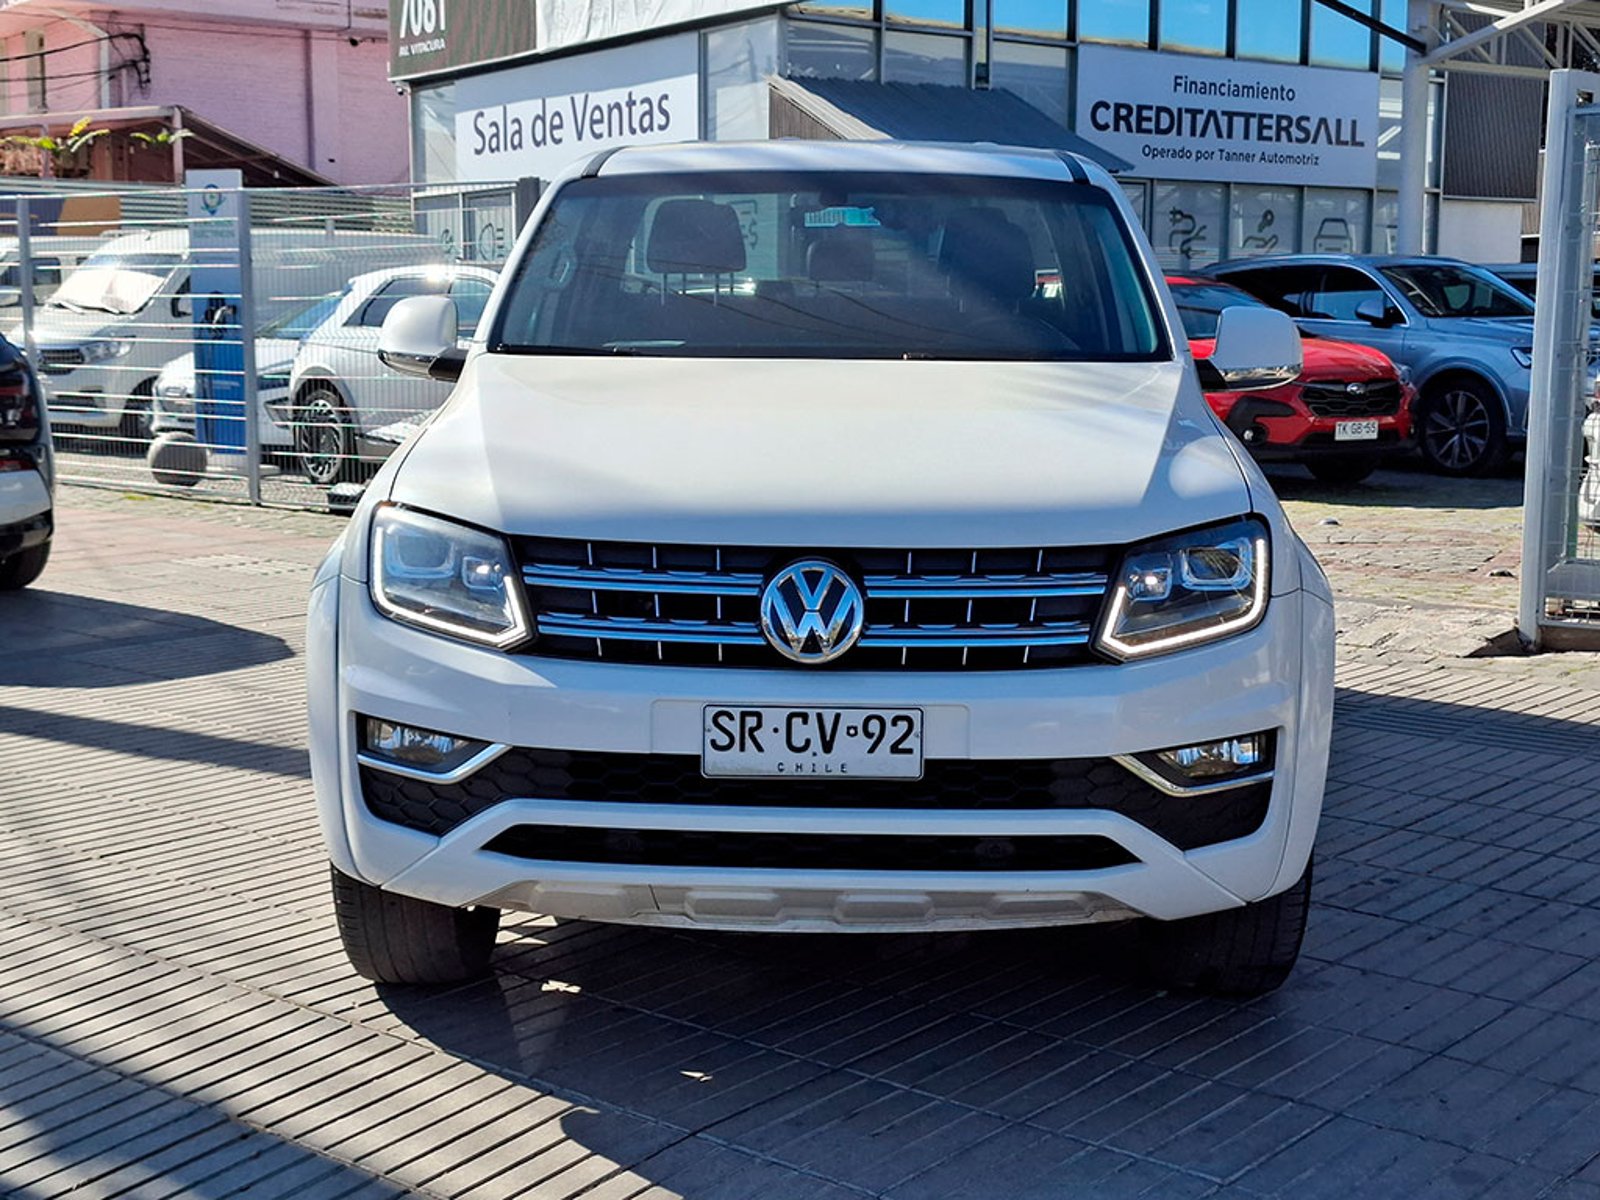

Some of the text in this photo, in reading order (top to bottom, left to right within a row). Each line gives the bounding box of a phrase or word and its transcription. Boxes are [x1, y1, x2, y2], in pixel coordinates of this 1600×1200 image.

[1173, 75, 1296, 101] Financiamiento
[473, 91, 671, 155] Sala de Ventas
[1090, 101, 1365, 147] CREDITATTERSALL
[1142, 144, 1320, 167] Operado por Tanner Automotriz
[777, 762, 848, 773] CHILE
